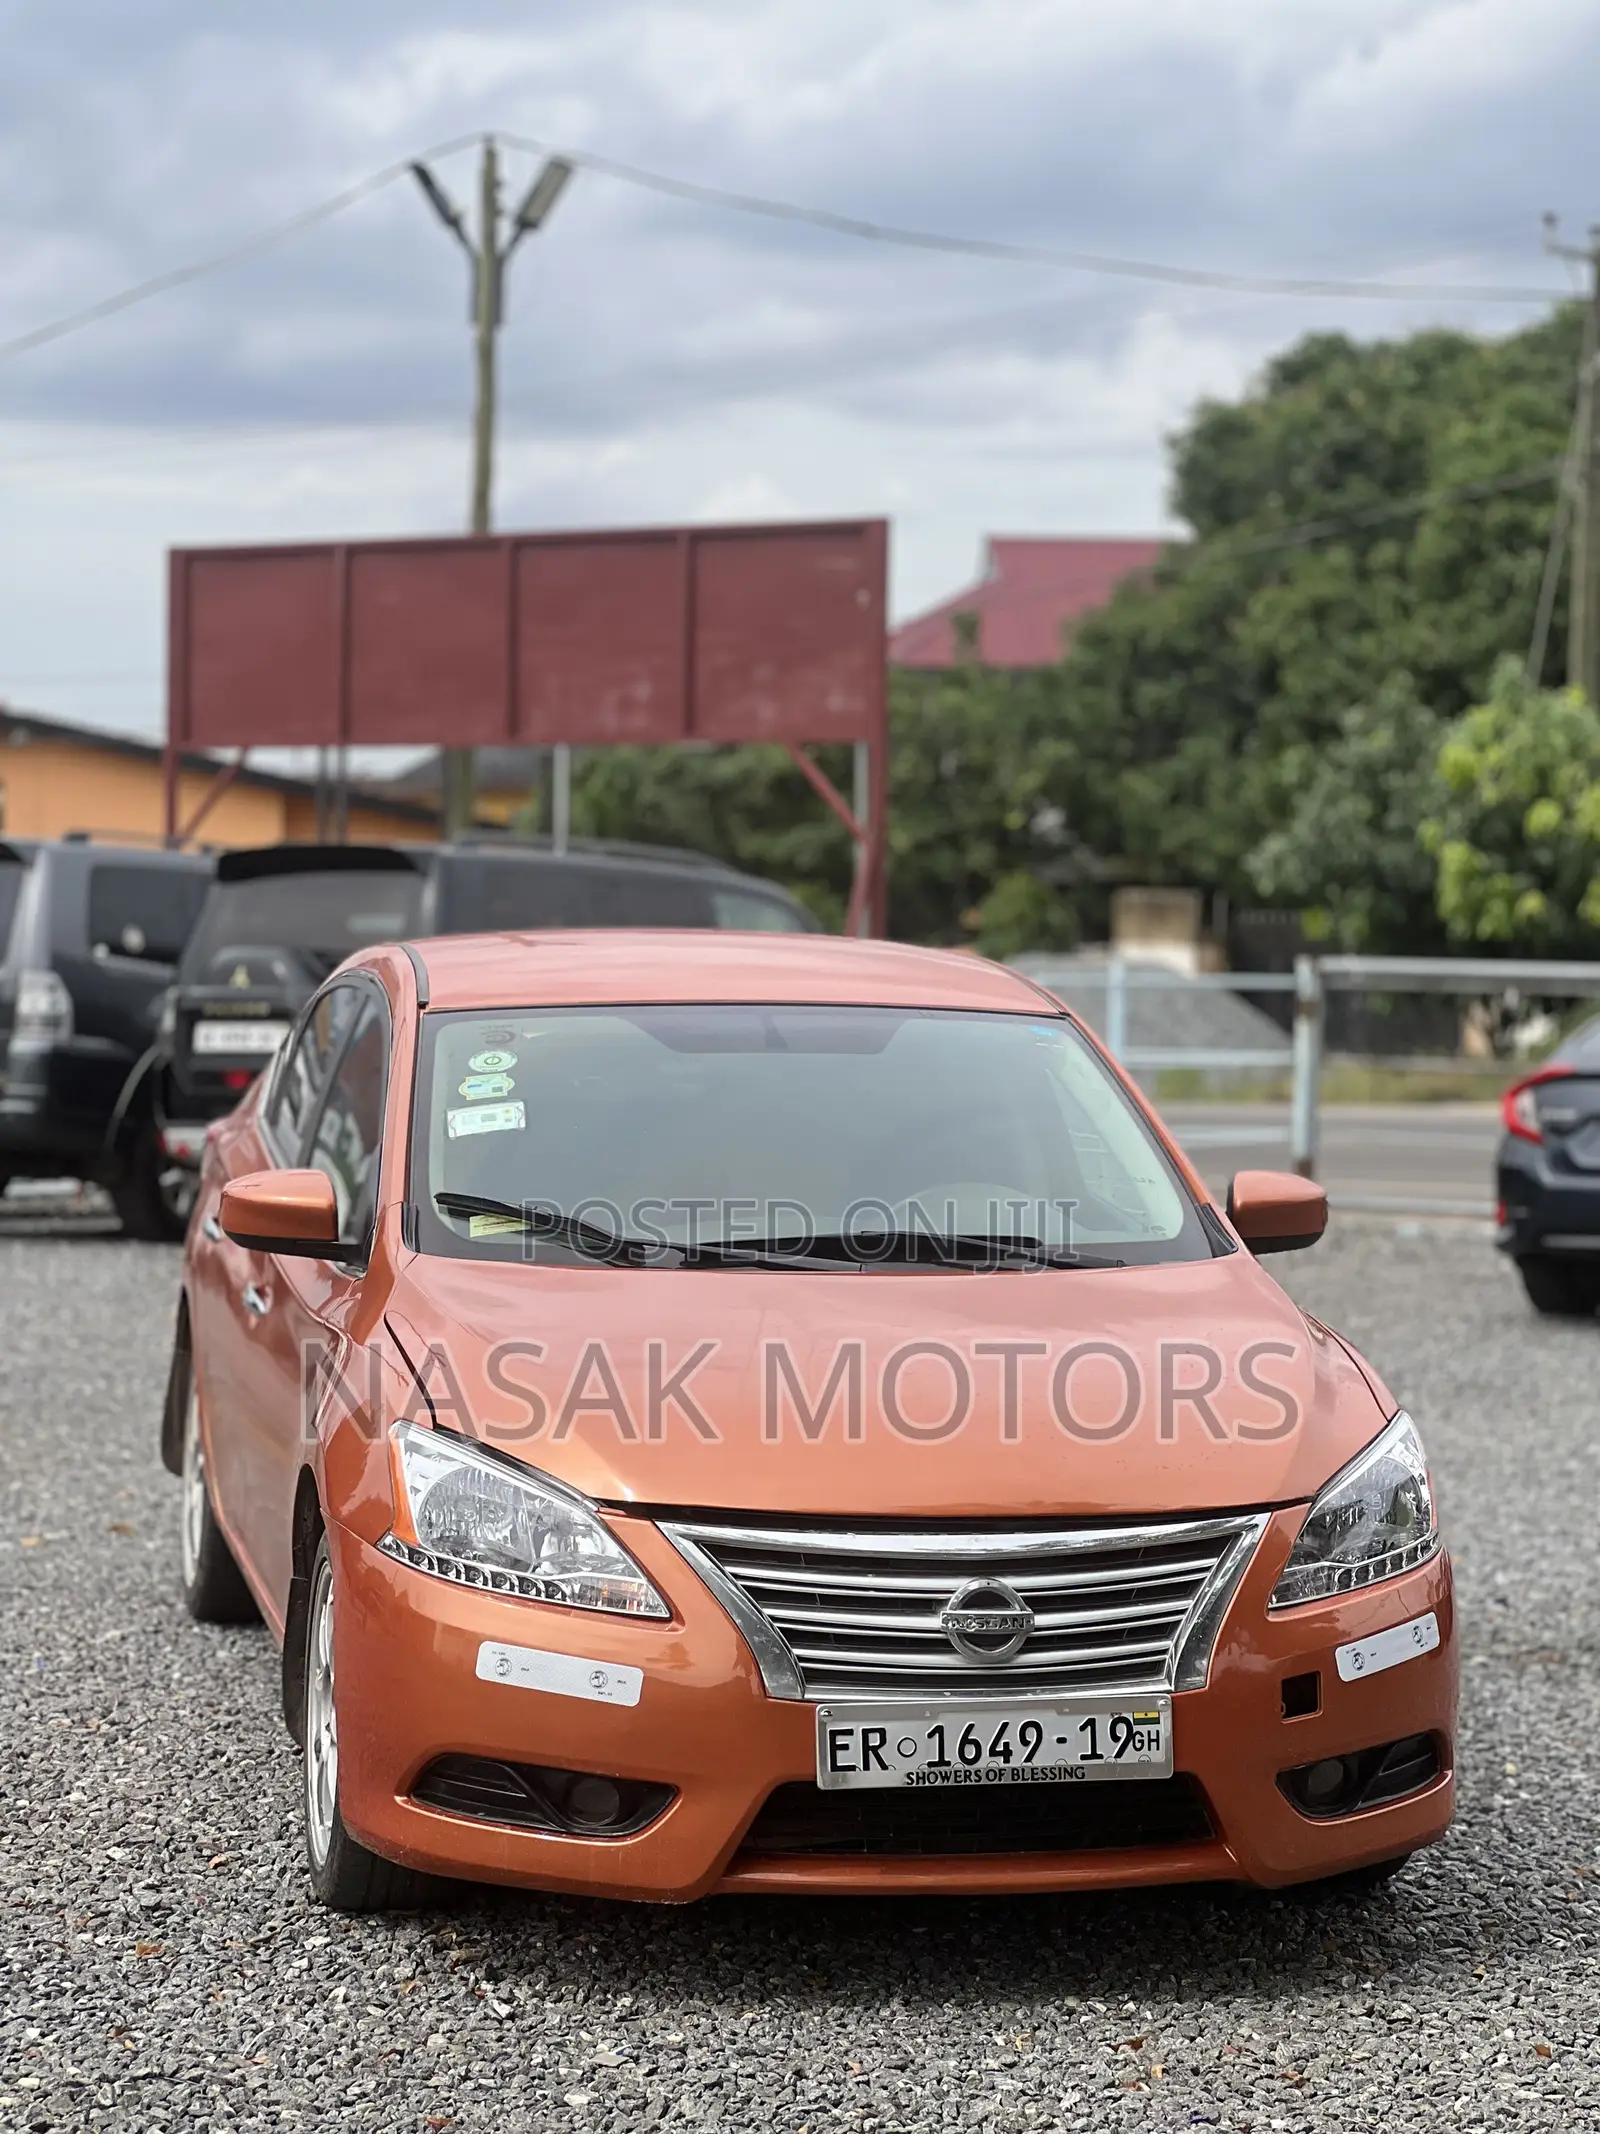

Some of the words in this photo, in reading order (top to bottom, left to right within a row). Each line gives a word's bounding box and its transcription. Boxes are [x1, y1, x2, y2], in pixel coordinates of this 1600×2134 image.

[828, 1727, 889, 1773] ER
[1132, 1729, 1160, 1752] GH
[906, 1770, 983, 1786] SHOWERS
[985, 1768, 1006, 1782] OF
[1011, 1766, 1086, 1782] BLESSING
